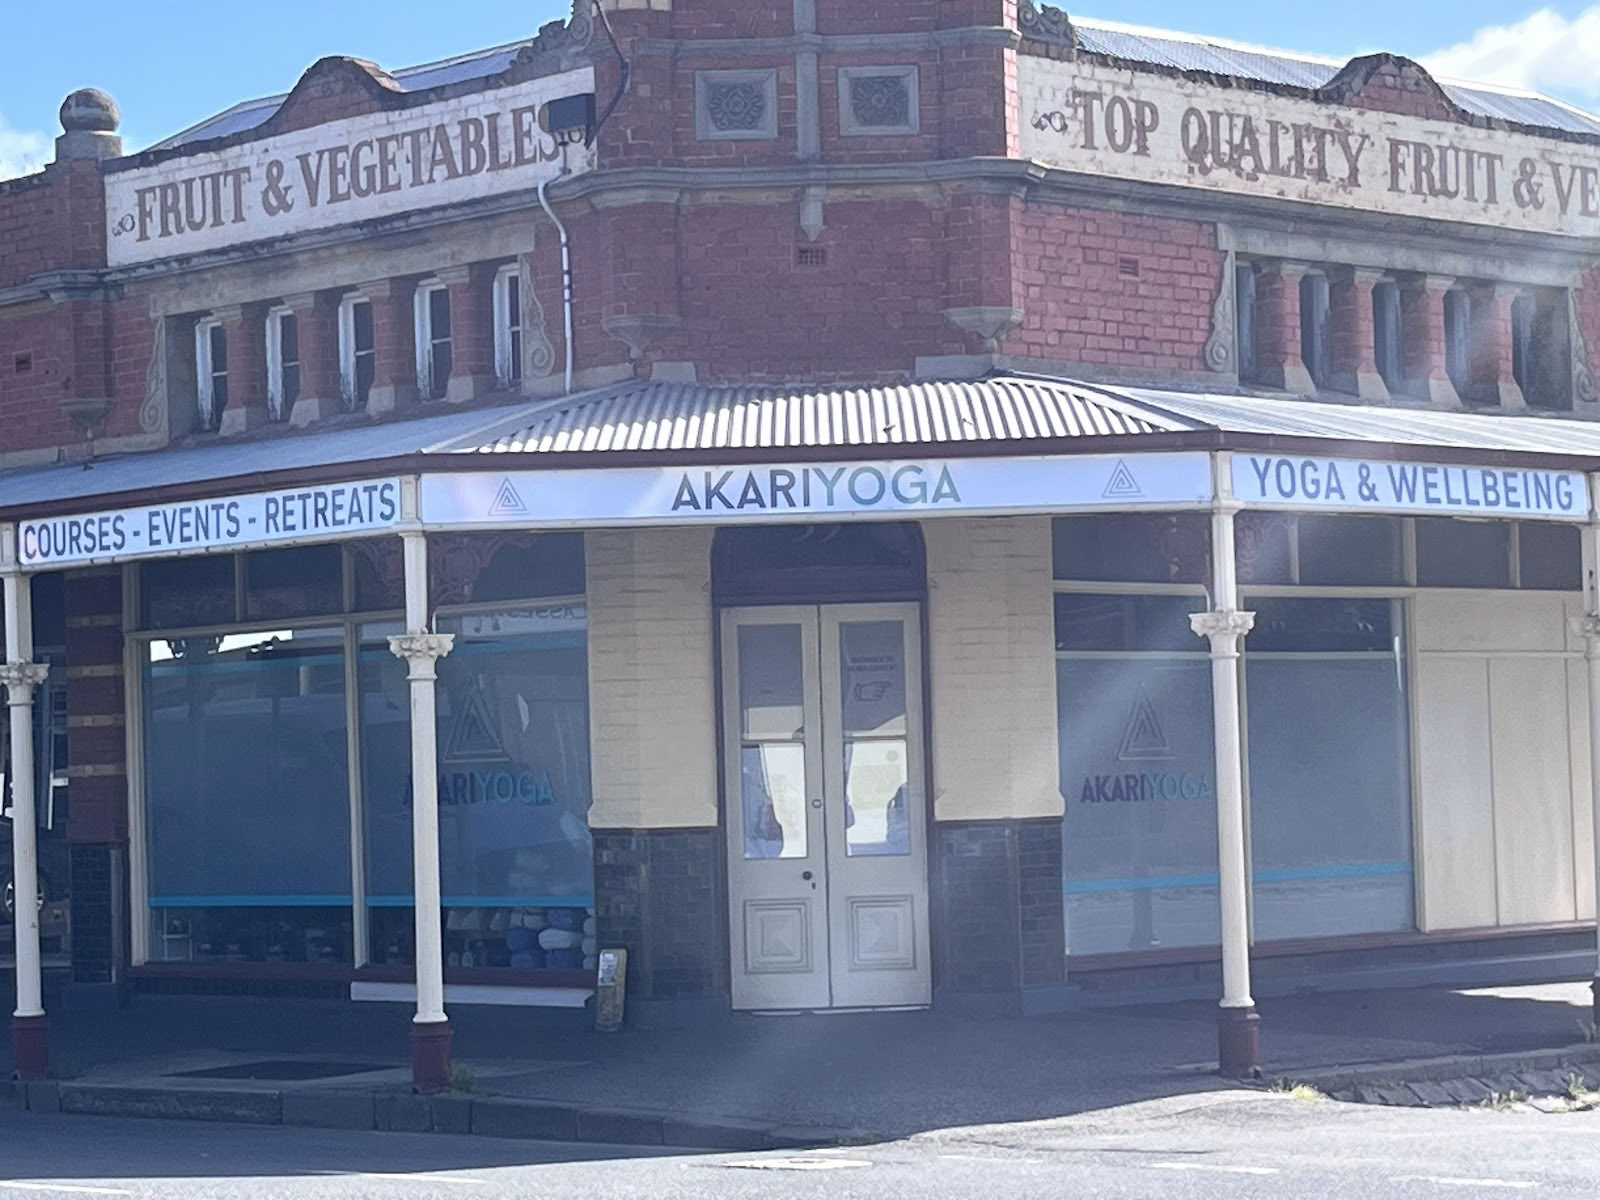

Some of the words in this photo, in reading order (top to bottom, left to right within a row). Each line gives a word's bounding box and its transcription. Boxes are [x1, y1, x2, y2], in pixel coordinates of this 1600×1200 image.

[134, 165, 252, 242] FRUIT
[261, 159, 294, 218] &
[296, 104, 560, 208] VEGETABLES
[1066, 90, 1159, 158] TOP
[1181, 107, 1370, 188] QUALITY
[1387, 137, 1504, 205] FRUIT
[1513, 157, 1545, 211] &
[671, 464, 961, 511] AKARIYOGA
[1250, 457, 1346, 500] YOGA
[1358, 463, 1380, 502] &
[1386, 465, 1573, 511] WELLBEING
[23, 514, 126, 560] COURSES
[148, 501, 240, 547] EVENTS
[264, 483, 395, 534] RETREATS
[1080, 772, 1213, 803] AKARIYOGA
